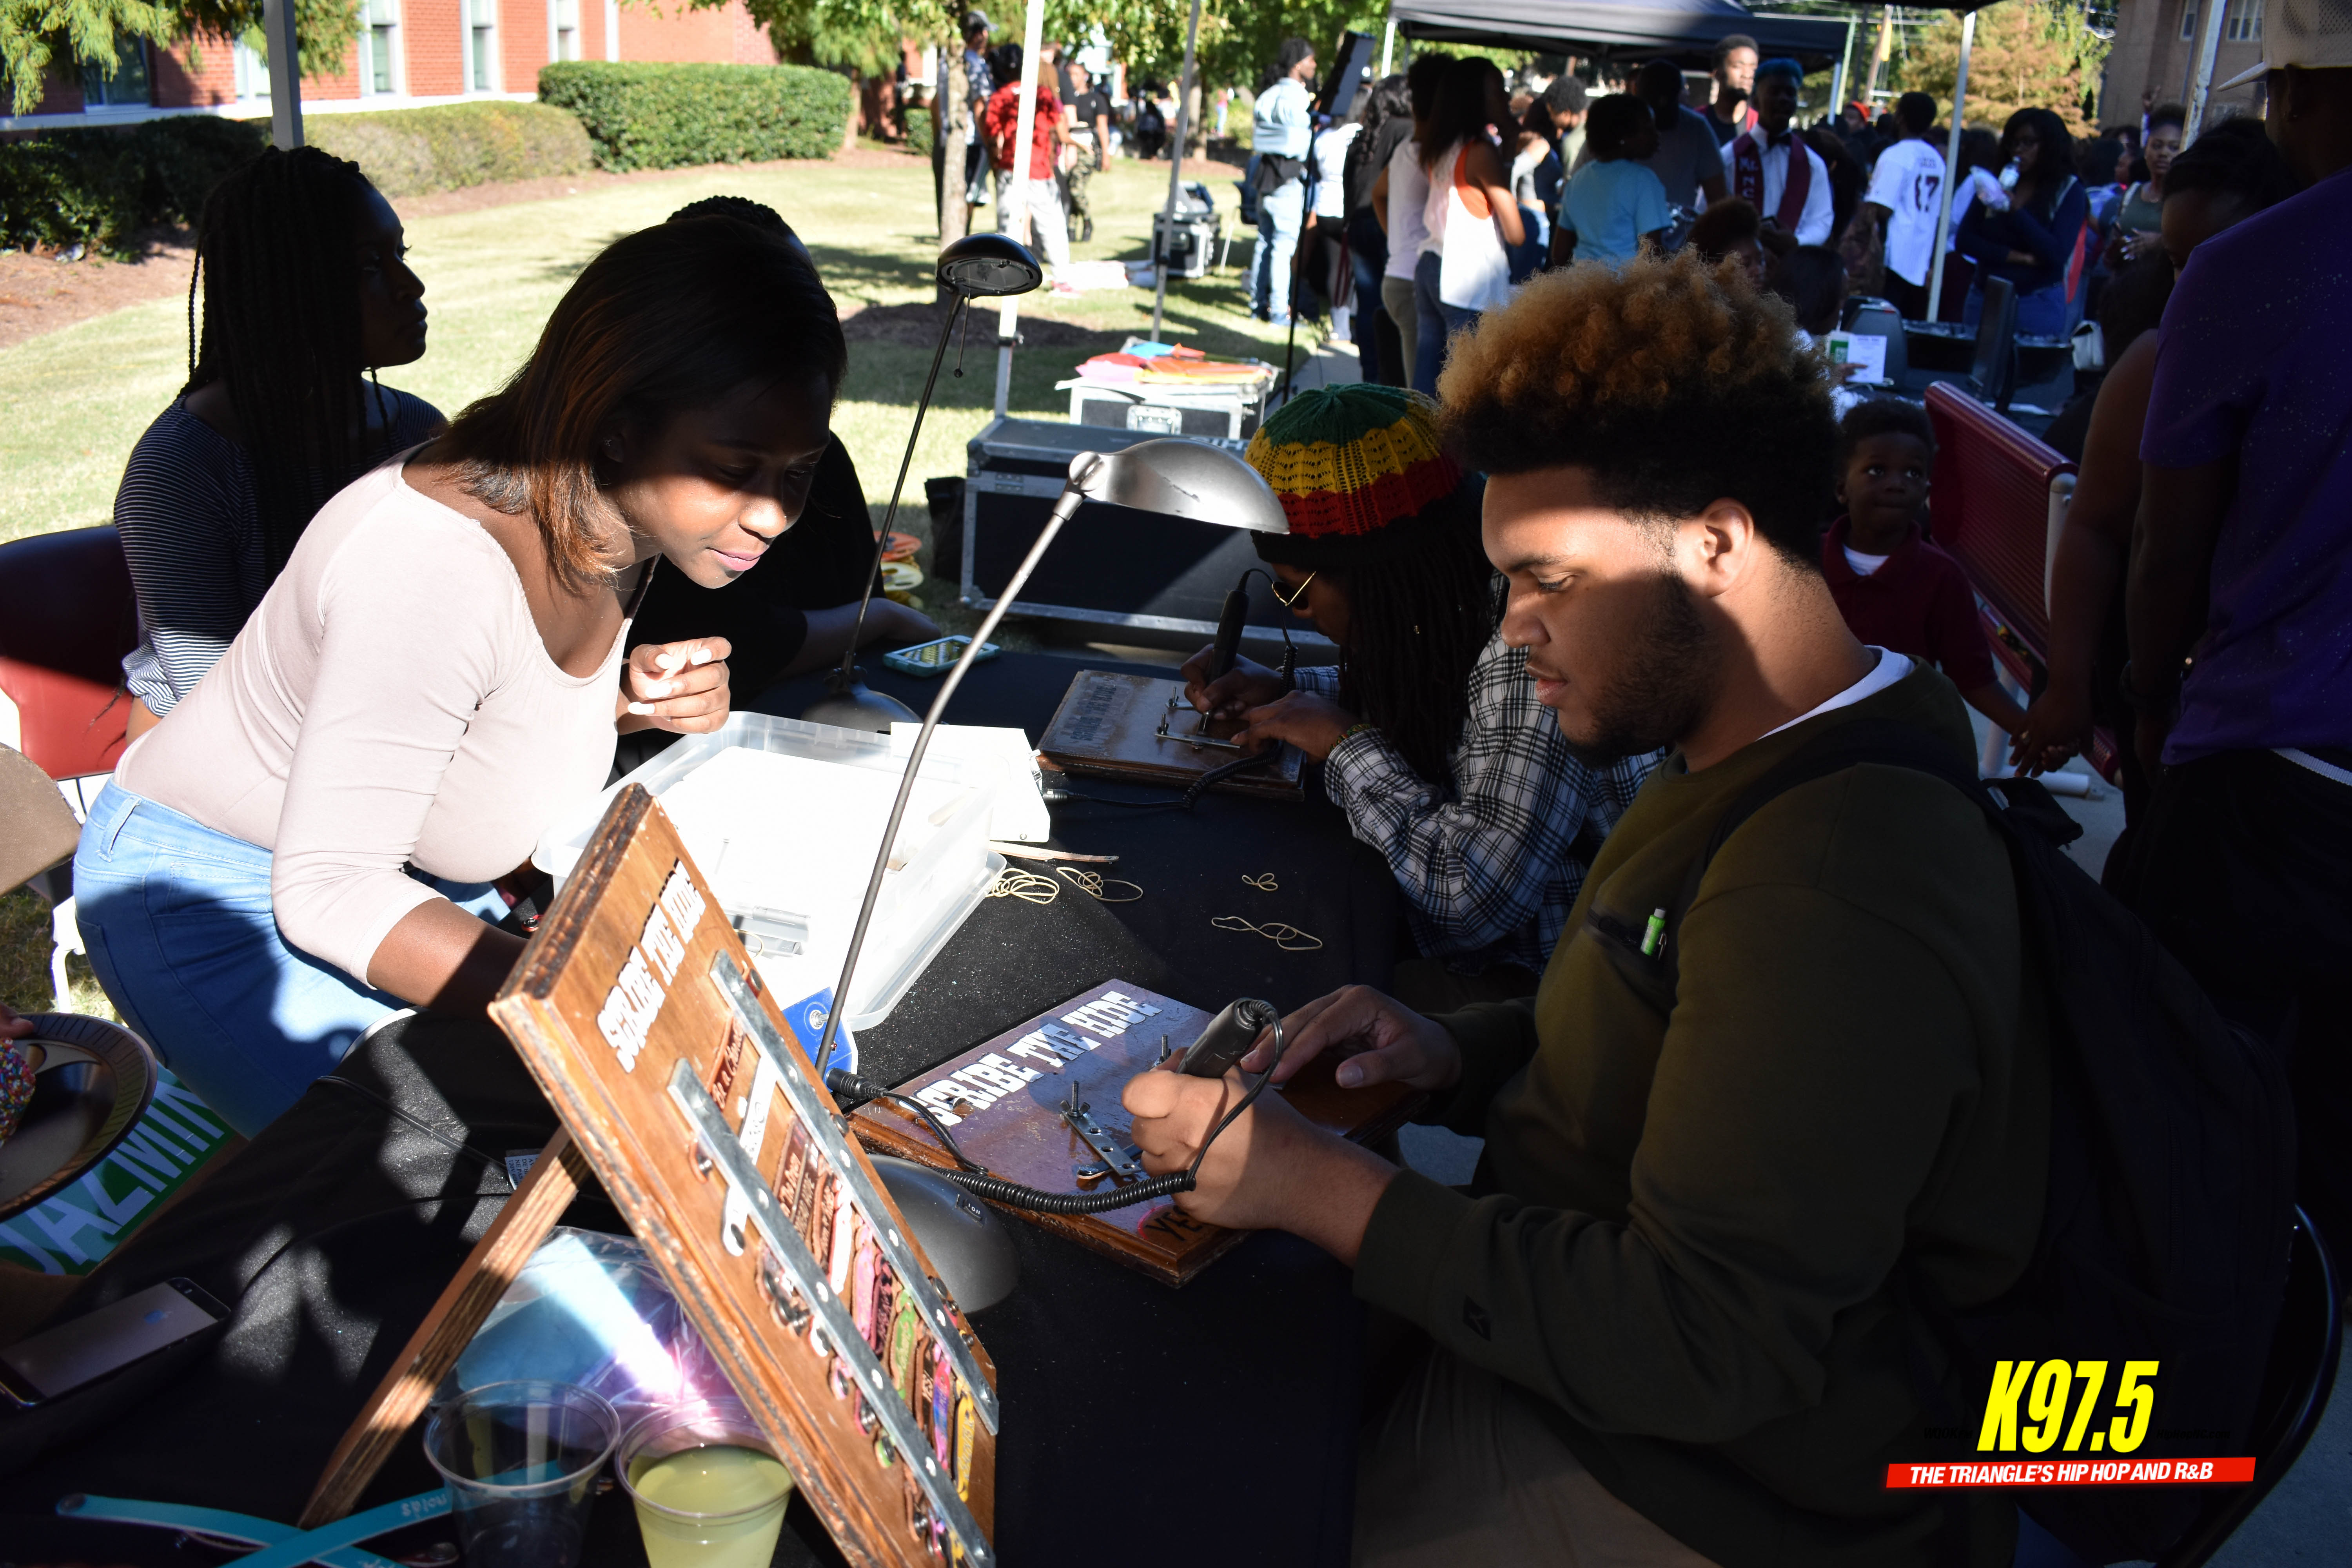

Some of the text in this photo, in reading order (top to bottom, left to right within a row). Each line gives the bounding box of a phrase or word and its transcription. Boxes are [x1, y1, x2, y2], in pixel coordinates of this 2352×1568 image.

[597, 857, 706, 1073] SCRIBE THE HIDE
[898, 991, 1163, 1126] SCRIBE THE HIDE
